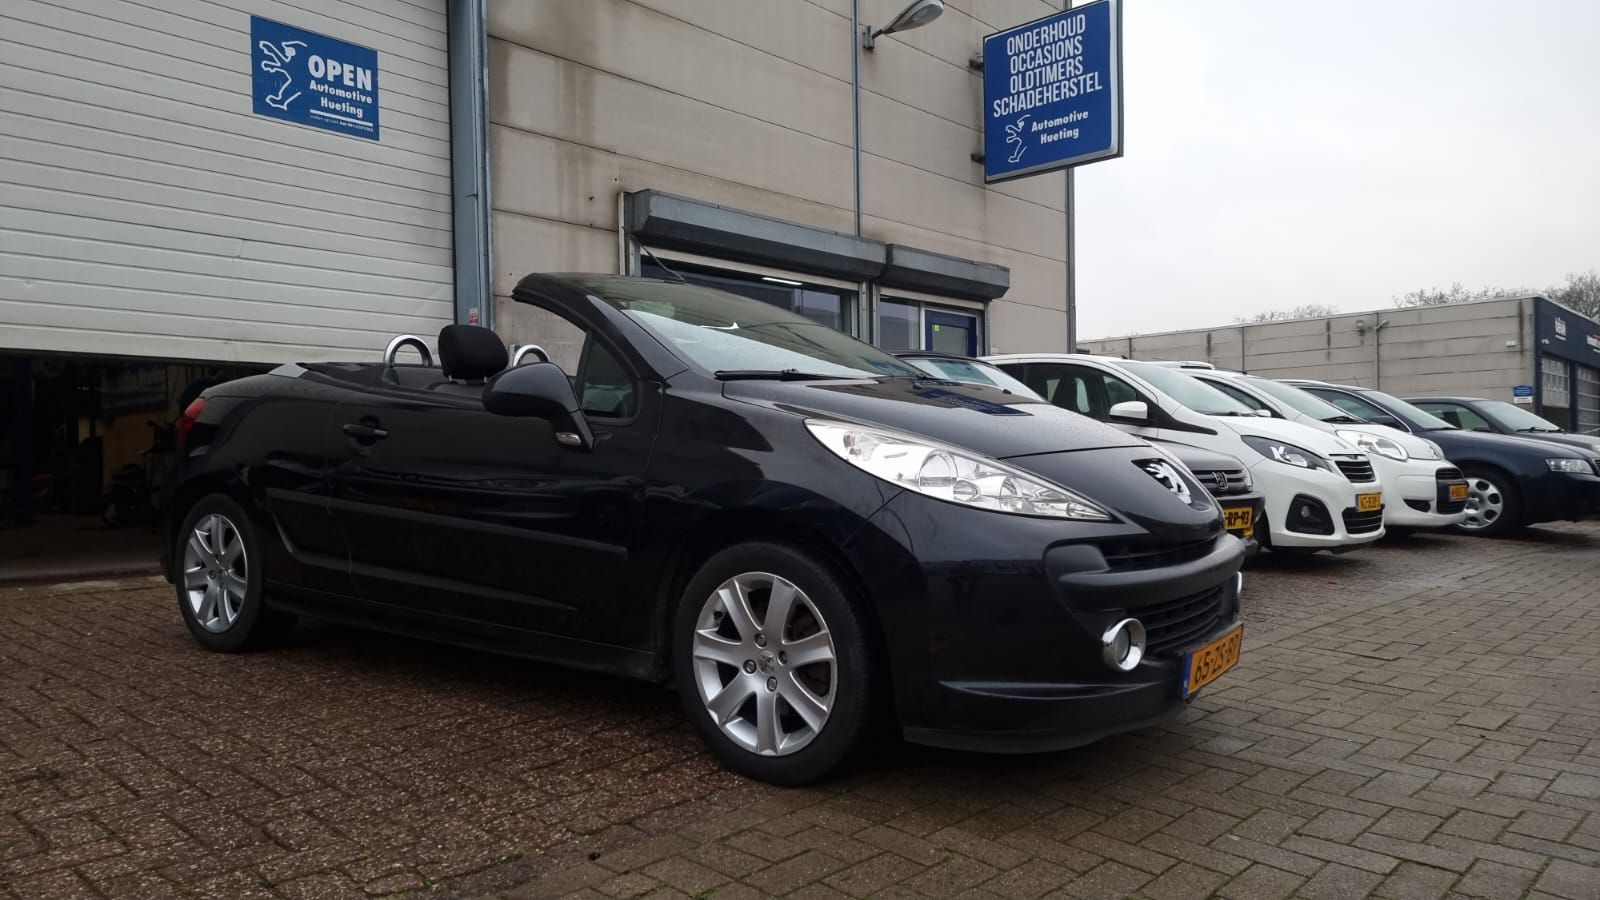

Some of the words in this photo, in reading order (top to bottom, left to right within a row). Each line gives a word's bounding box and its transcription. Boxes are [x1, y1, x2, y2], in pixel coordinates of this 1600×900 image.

[1007, 14, 1086, 56] ONDERHOUD
[1010, 35, 1083, 74] OCCASIONS
[308, 54, 372, 91] OPEN
[1010, 56, 1083, 94] OLDTIMERS
[310, 80, 373, 104] Automotive
[993, 72, 1103, 118] SCHADEHERSTEL
[321, 97, 363, 118] Hueting
[1032, 110, 1089, 132] Automotive
[1040, 128, 1079, 145] Hueting
[1224, 510, 1250, 527] -RP-93
